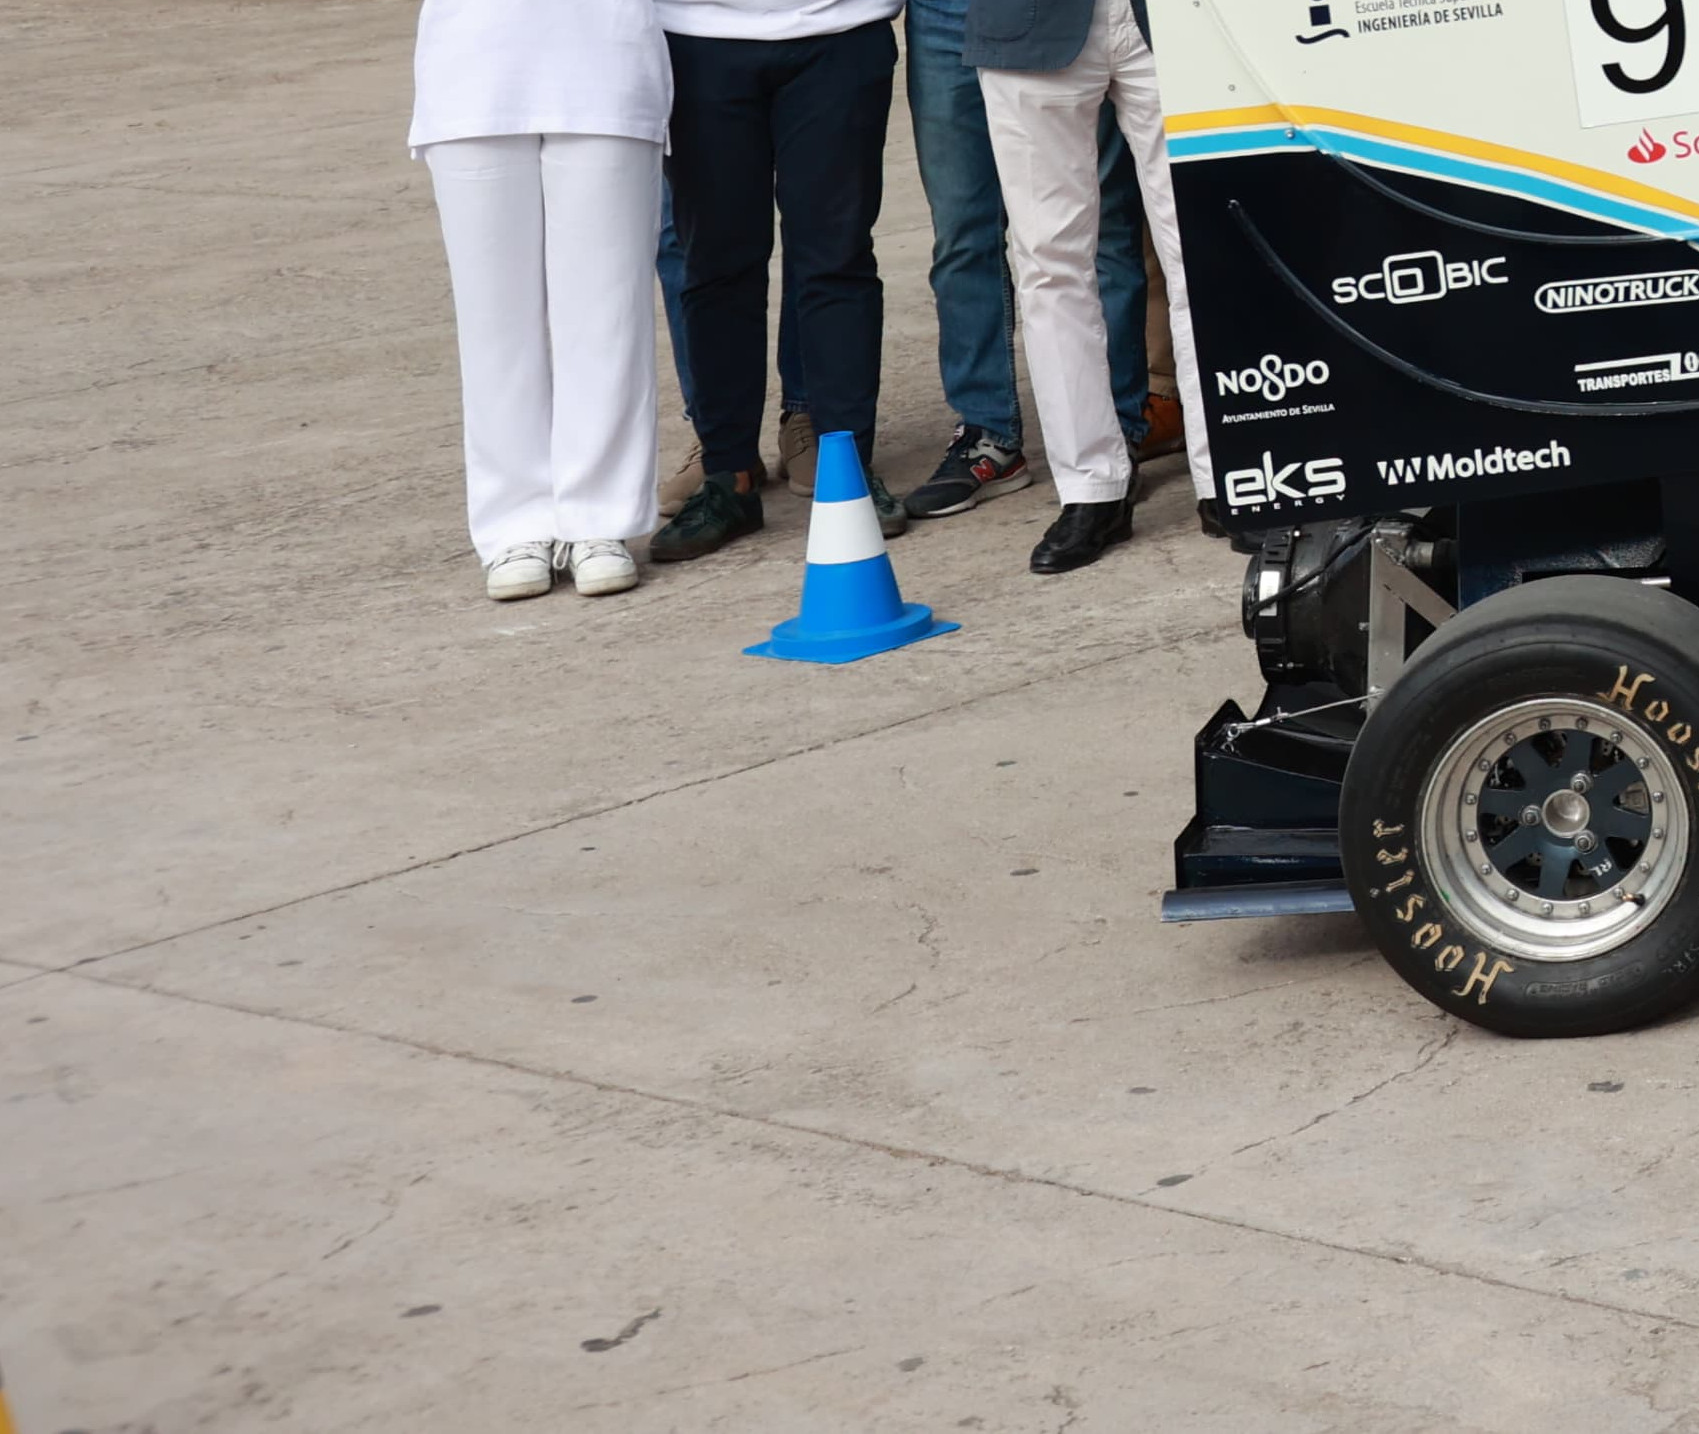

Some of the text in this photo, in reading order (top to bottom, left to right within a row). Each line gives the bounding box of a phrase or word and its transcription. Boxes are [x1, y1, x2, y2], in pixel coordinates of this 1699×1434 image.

[1358, 2, 1503, 33] INGENIERÍA DE SEVILLA
[1547, 275, 1699, 310] NINOTRUCK
[1577, 369, 1671, 392] TRANSPORTES
[1225, 451, 1346, 506] eks
[1427, 441, 1571, 481] Moldtech
[1231, 494, 1345, 515] ENERGY
[1371, 818, 1515, 1005] Hoosier
